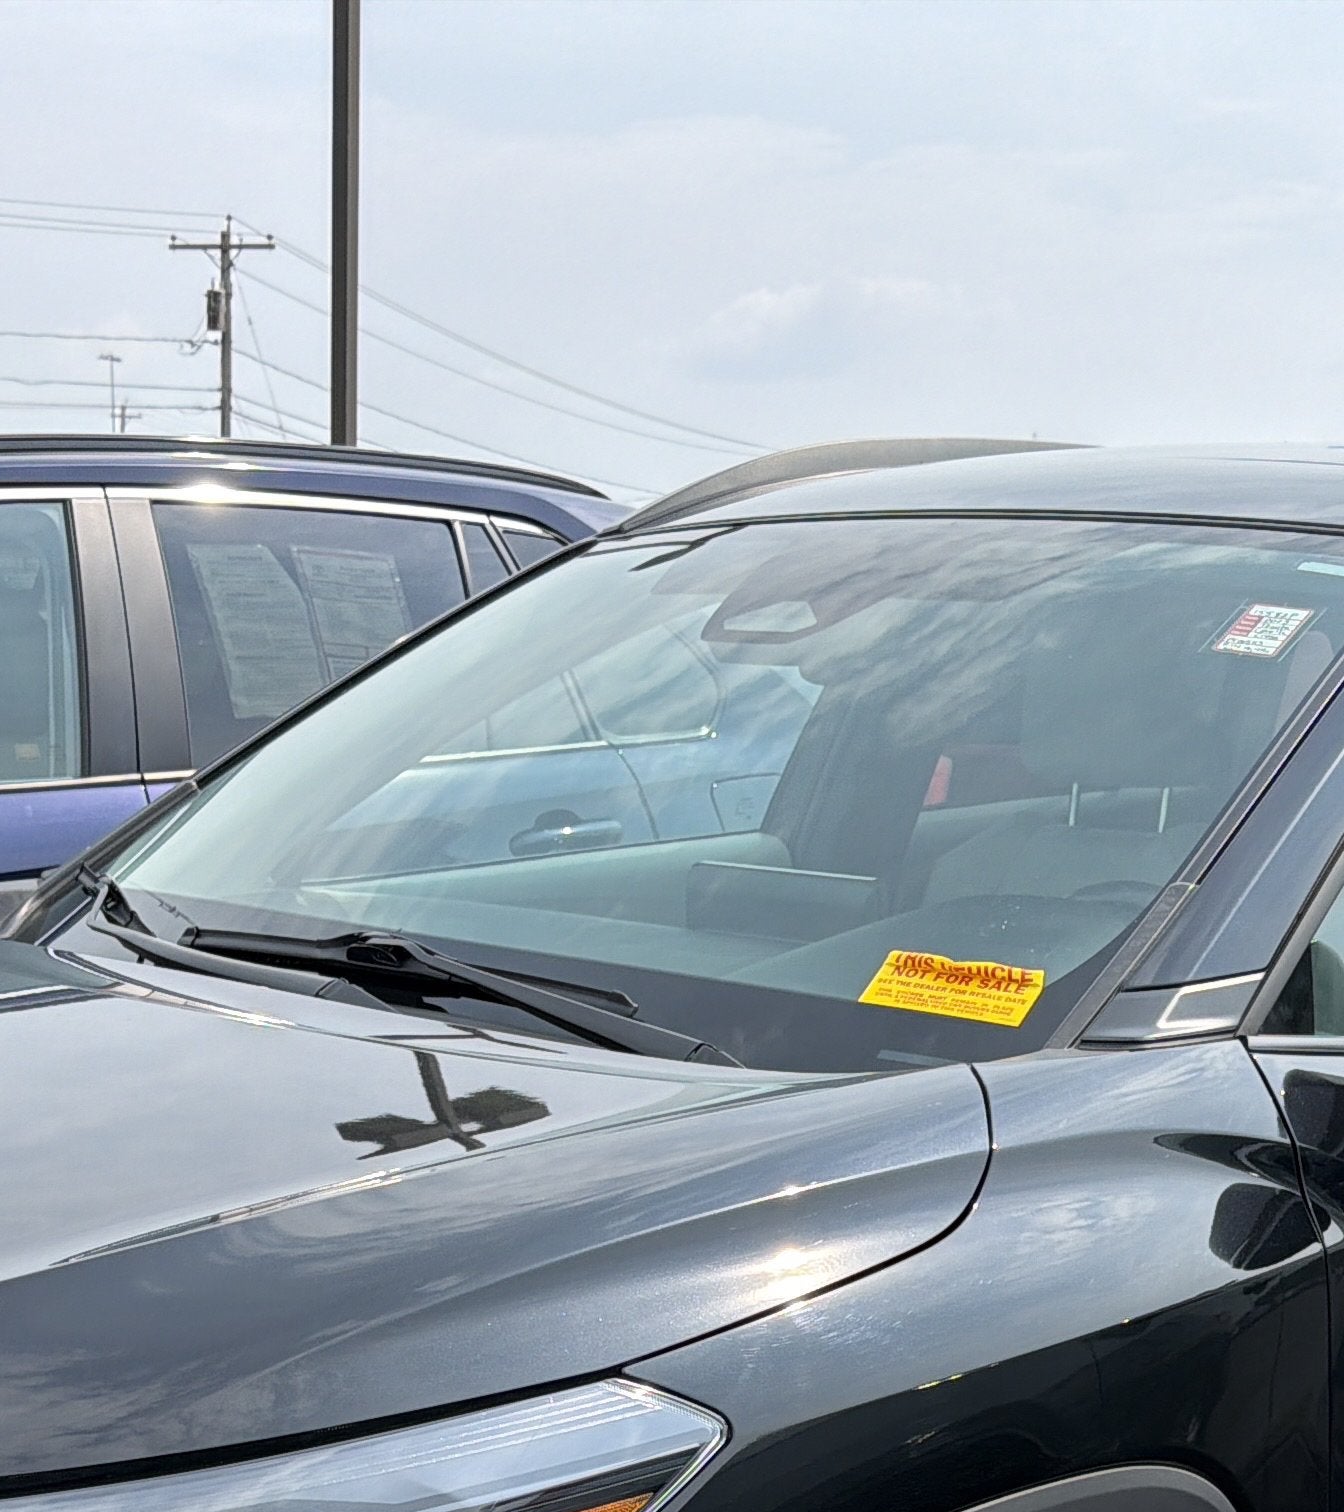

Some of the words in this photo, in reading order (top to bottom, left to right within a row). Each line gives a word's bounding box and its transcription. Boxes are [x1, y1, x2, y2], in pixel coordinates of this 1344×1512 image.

[891, 965, 931, 980] NOT
[932, 971, 973, 987] FOR
[976, 978, 1027, 995] SALE
[913, 982, 947, 993] DEALER
[949, 987, 967, 996] FOR
